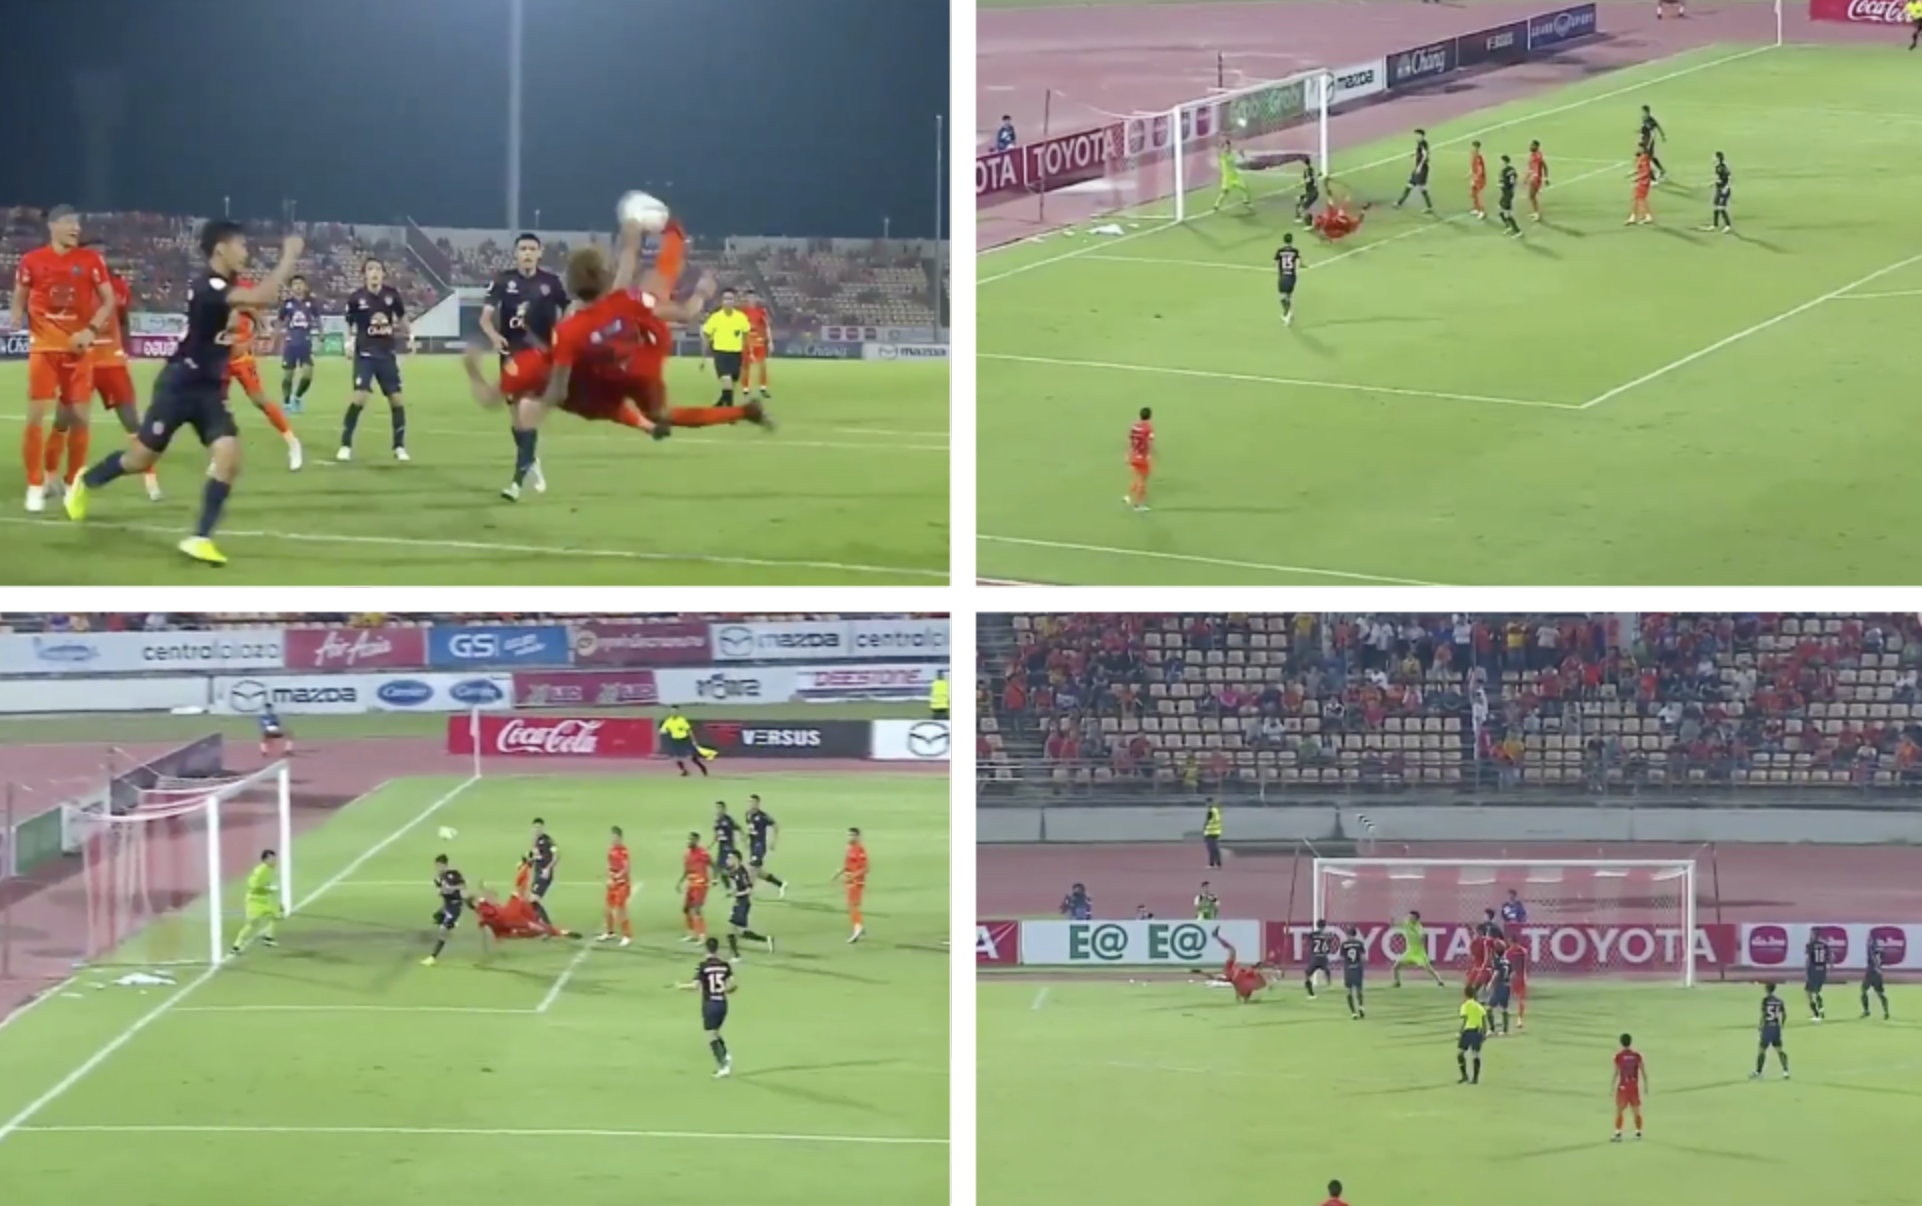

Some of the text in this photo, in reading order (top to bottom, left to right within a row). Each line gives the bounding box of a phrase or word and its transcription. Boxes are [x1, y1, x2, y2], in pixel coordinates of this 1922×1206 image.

[1033, 129, 1117, 176] TOYOTA
[448, 633, 495, 658] GS
[757, 632, 840, 648] mazda
[271, 687, 356, 703] mazda
[742, 729, 821, 746] VERSUS
[1069, 923, 1207, 960] E@ E@
[1521, 926, 1717, 963] TOYOTA
[708, 972, 725, 993] 15
